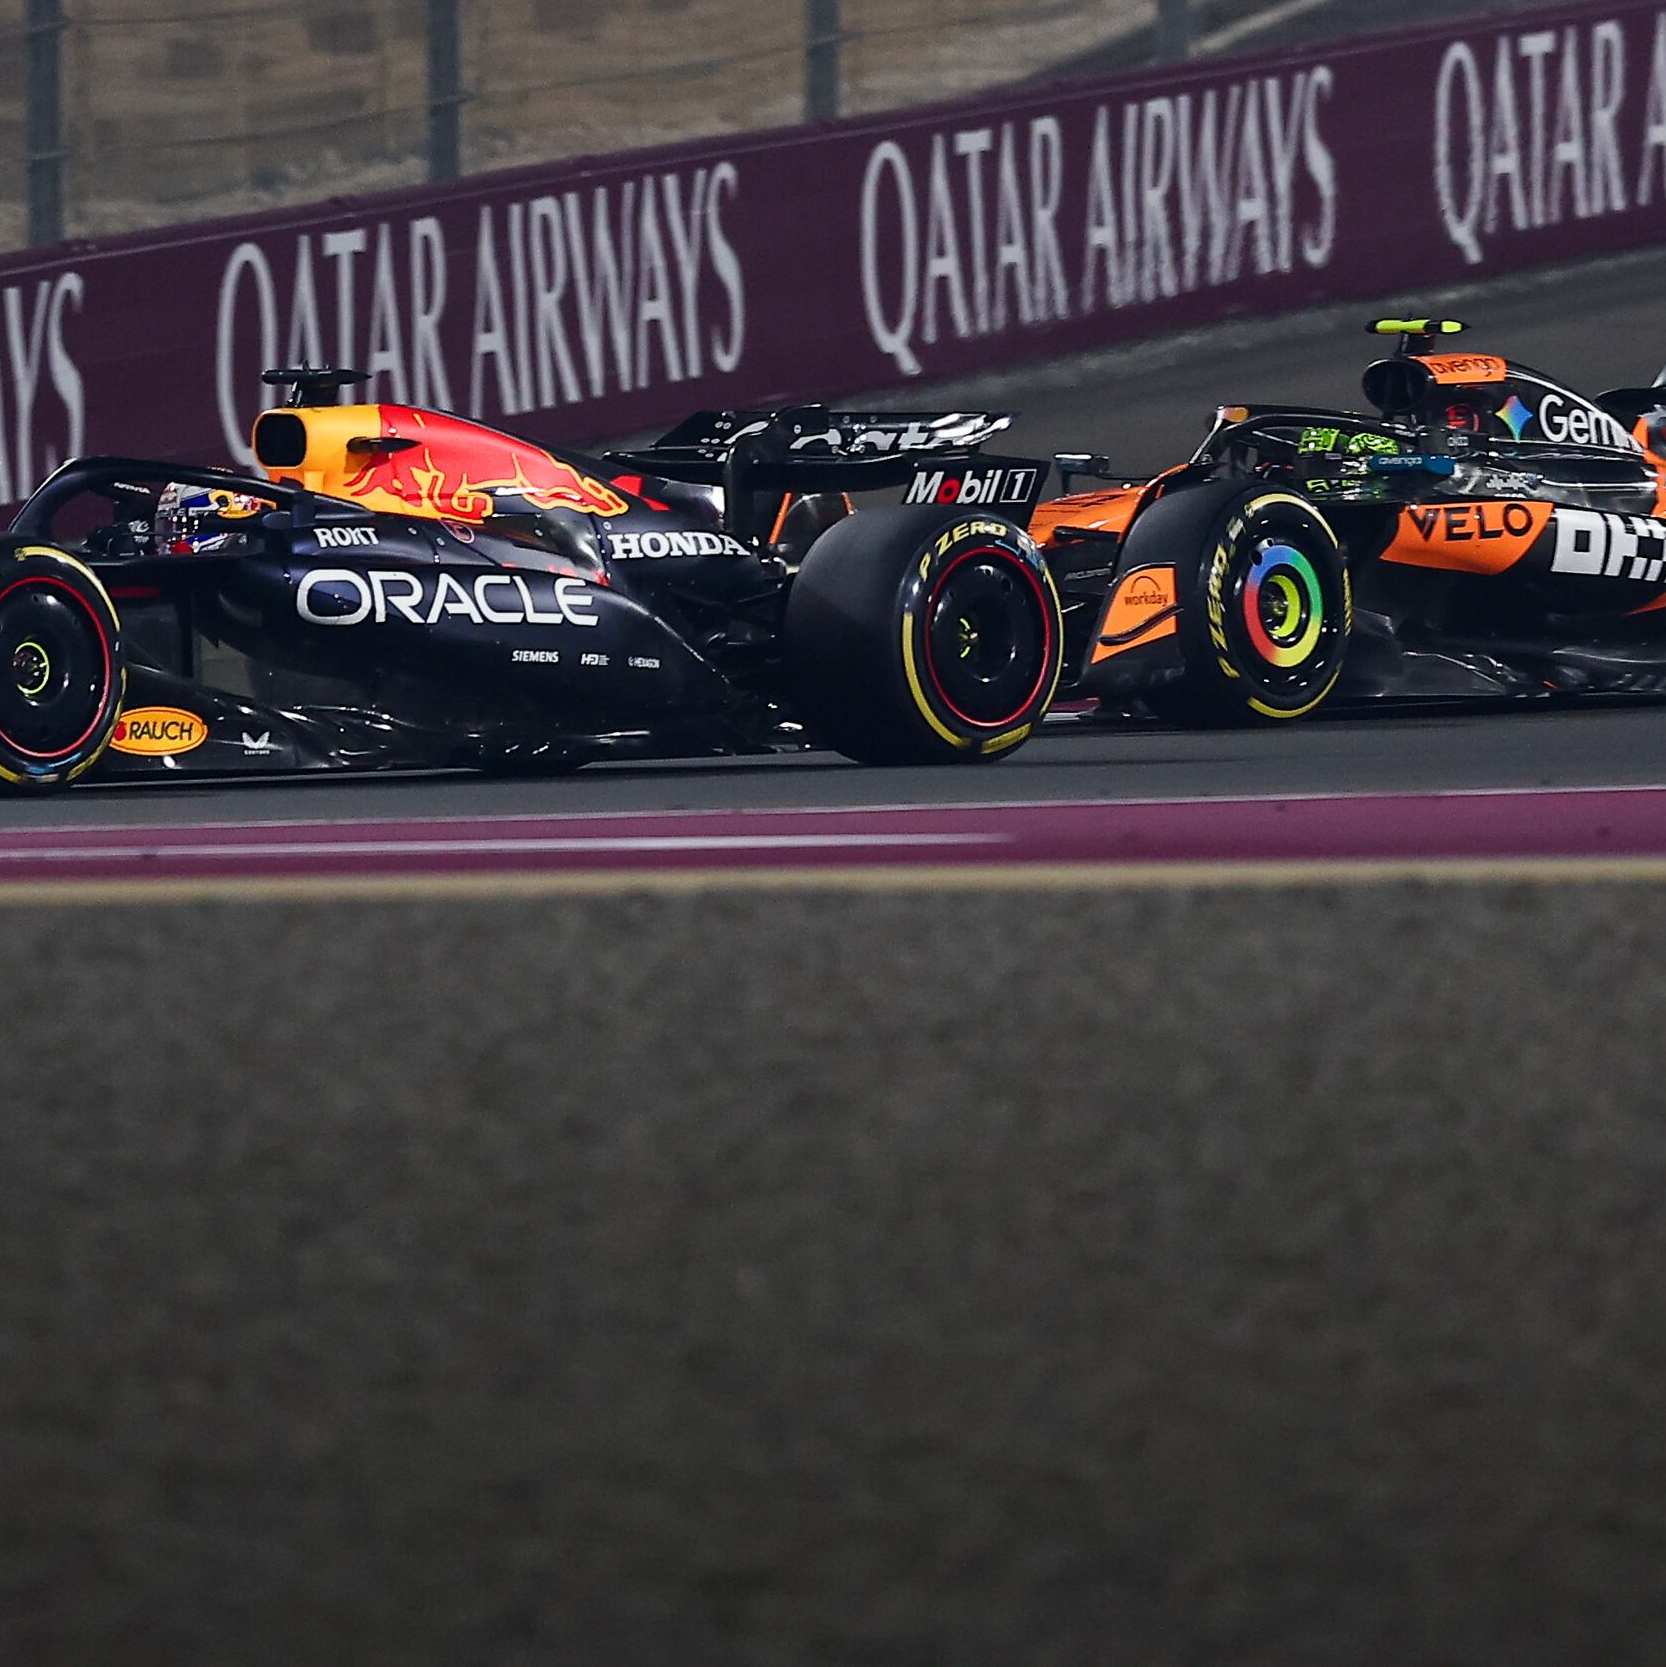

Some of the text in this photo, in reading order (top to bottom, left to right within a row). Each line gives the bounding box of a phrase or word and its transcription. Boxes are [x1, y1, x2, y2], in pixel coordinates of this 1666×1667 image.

[1435, 20, 1627, 264] QATAR
[862, 65, 1336, 376] QATAR AIRWAYS
[216, 163, 745, 476] QATAR AIRWAYS
[905, 470, 1002, 505] Mobil
[1407, 503, 1534, 542] VELO
[607, 531, 752, 560] HONDA
[919, 520, 1009, 583] P ZERO
[297, 569, 598, 626] ORACLE
[1124, 591, 1169, 607] workday
[511, 649, 559, 663] SIEMENS
[129, 721, 194, 741] RAUCH
